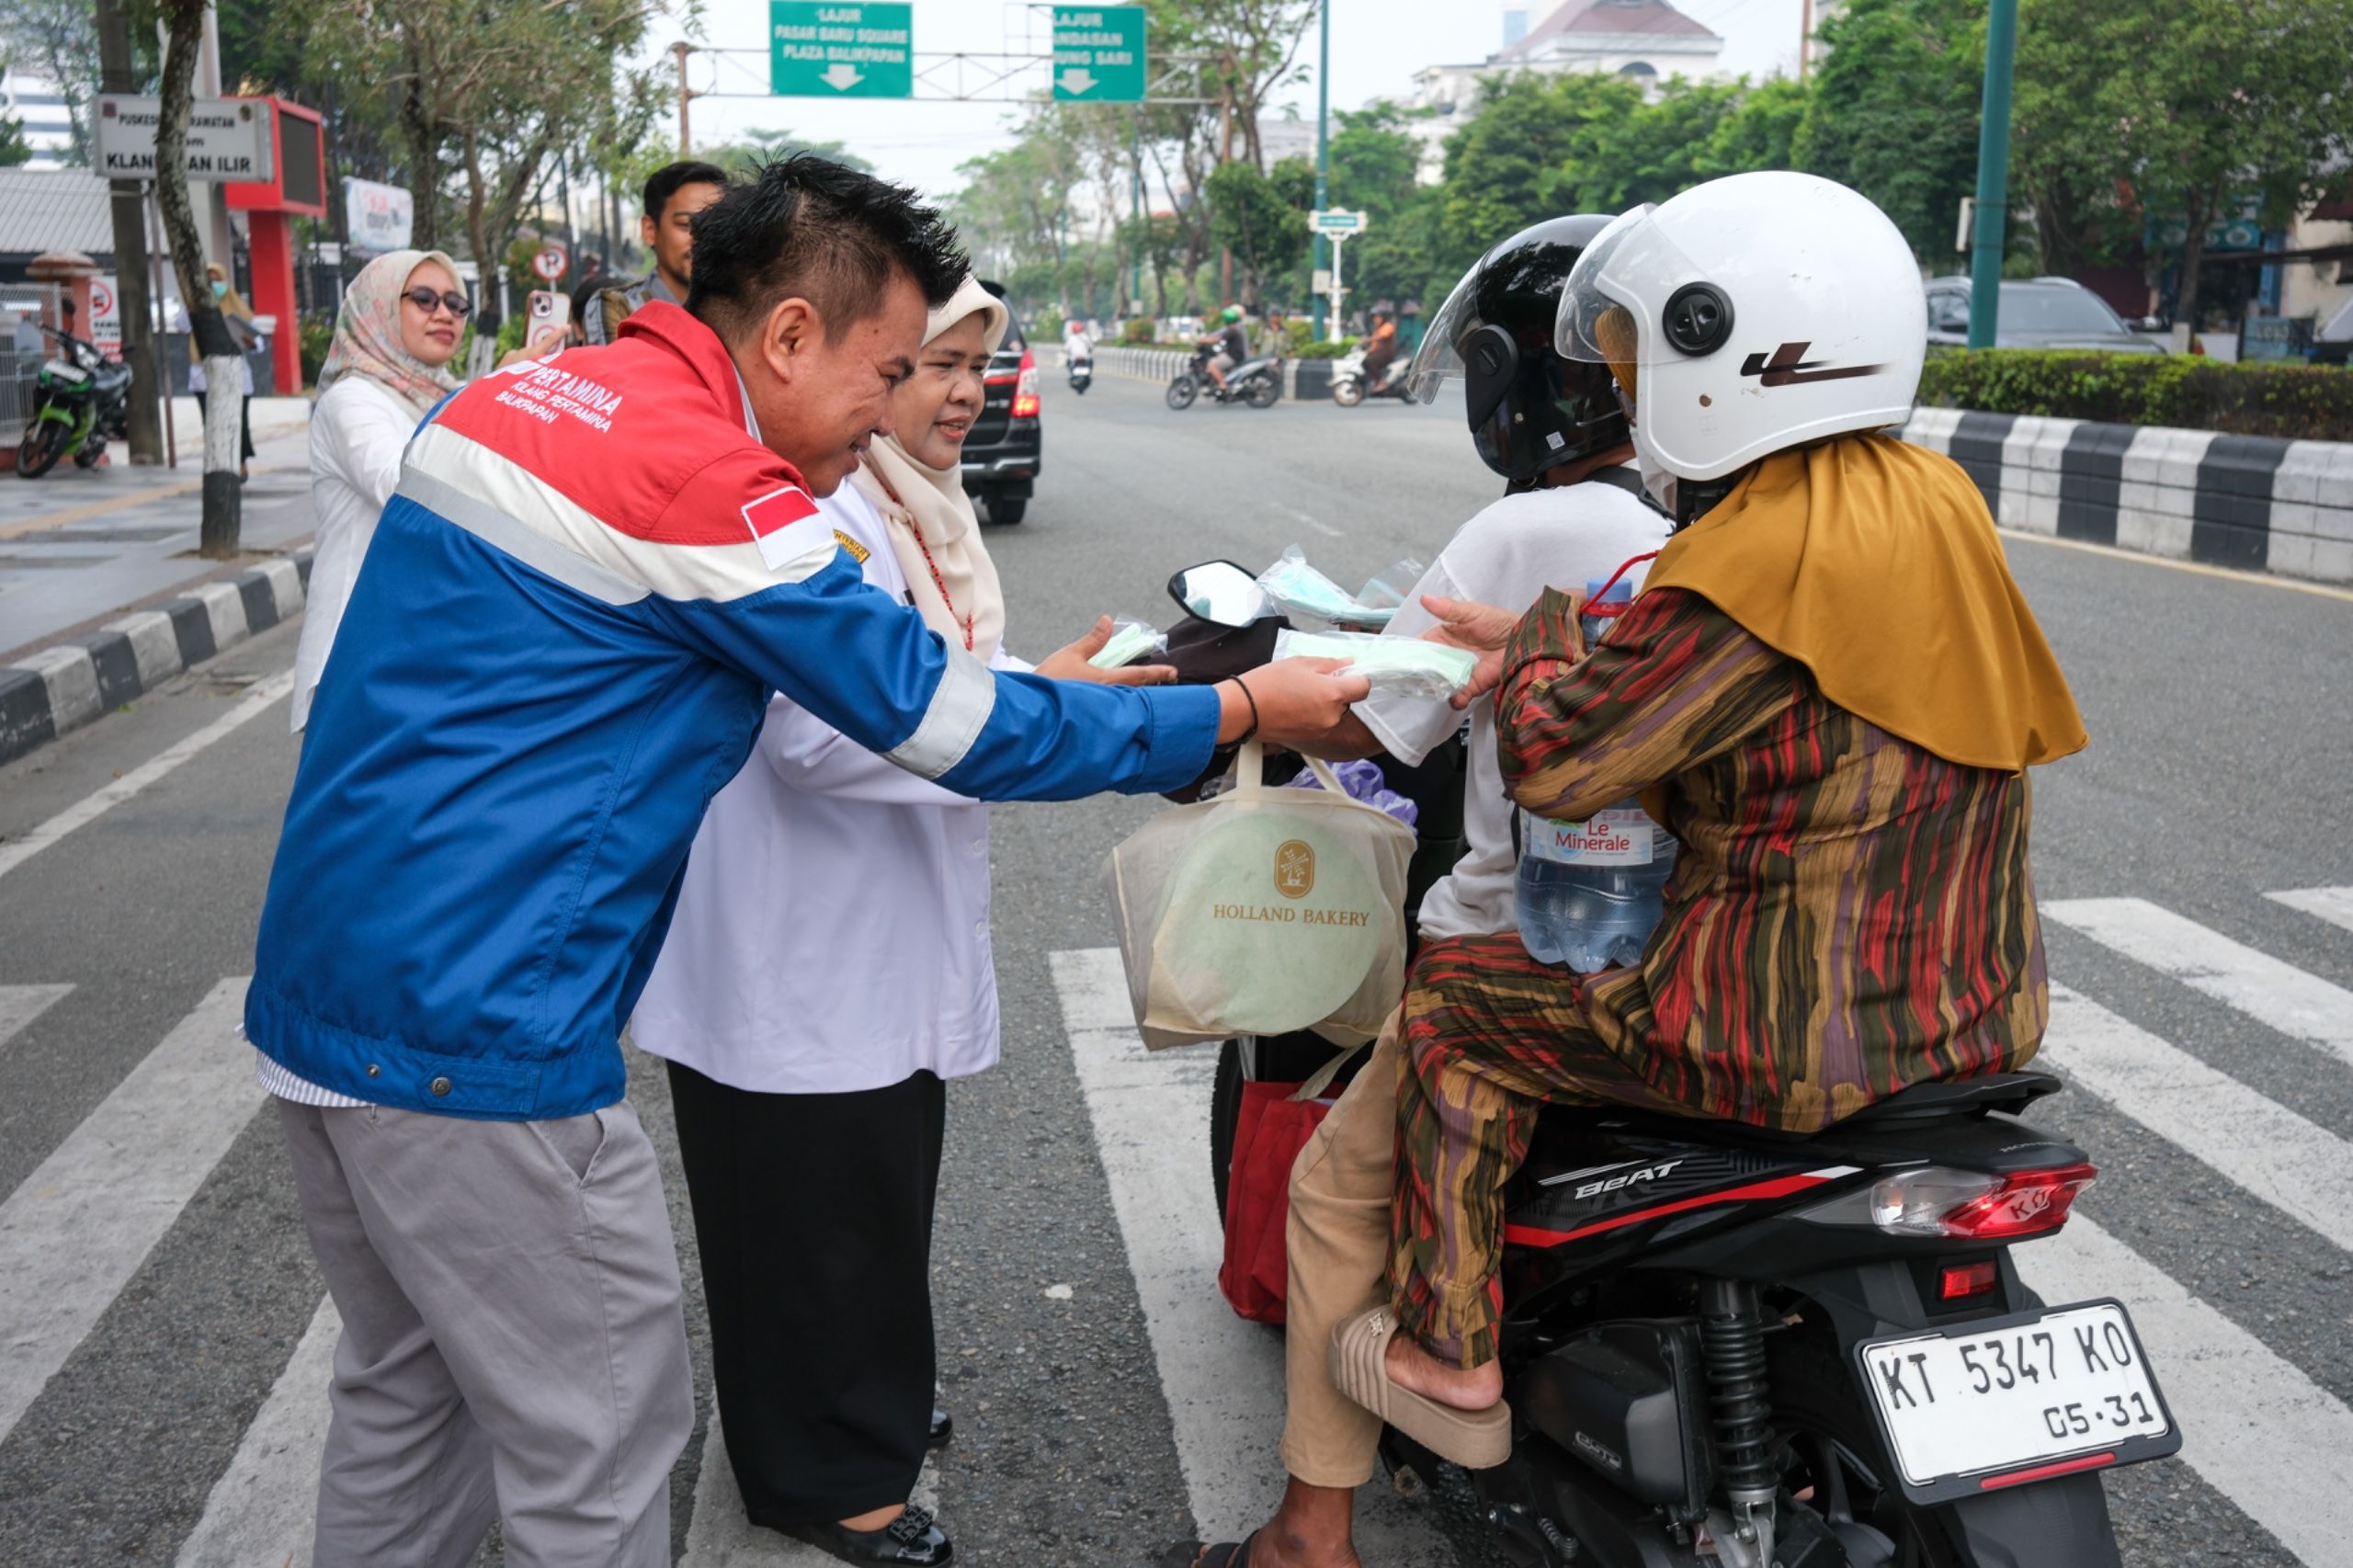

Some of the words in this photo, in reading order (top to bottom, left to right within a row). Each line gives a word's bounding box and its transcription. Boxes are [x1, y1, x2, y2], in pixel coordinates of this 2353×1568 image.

[817, 7, 862, 23] LAJUR
[775, 24, 816, 40] PASAR
[818, 26, 855, 42] BARU
[856, 28, 908, 44] SQUARE
[782, 43, 824, 60] PLAZA
[826, 46, 905, 63] BALIKPAPAN
[1095, 51, 1132, 65] SARI
[107, 153, 211, 172] KLANAN
[218, 156, 251, 173] ILIR
[524, 366, 623, 416] PERTAMINA
[494, 391, 560, 425] BALIKPAPAN
[510, 381, 551, 400] KILANG
[546, 393, 612, 433] PERTAMINA
[1587, 817, 1609, 836] Le
[1555, 831, 1631, 851] Minerale
[1212, 903, 1296, 922] HOLLAND
[1302, 908, 1370, 927] BAKERY
[1879, 1353, 1935, 1410] KT
[1959, 1332, 2058, 1394] 5347
[2074, 1321, 2131, 1373] KO
